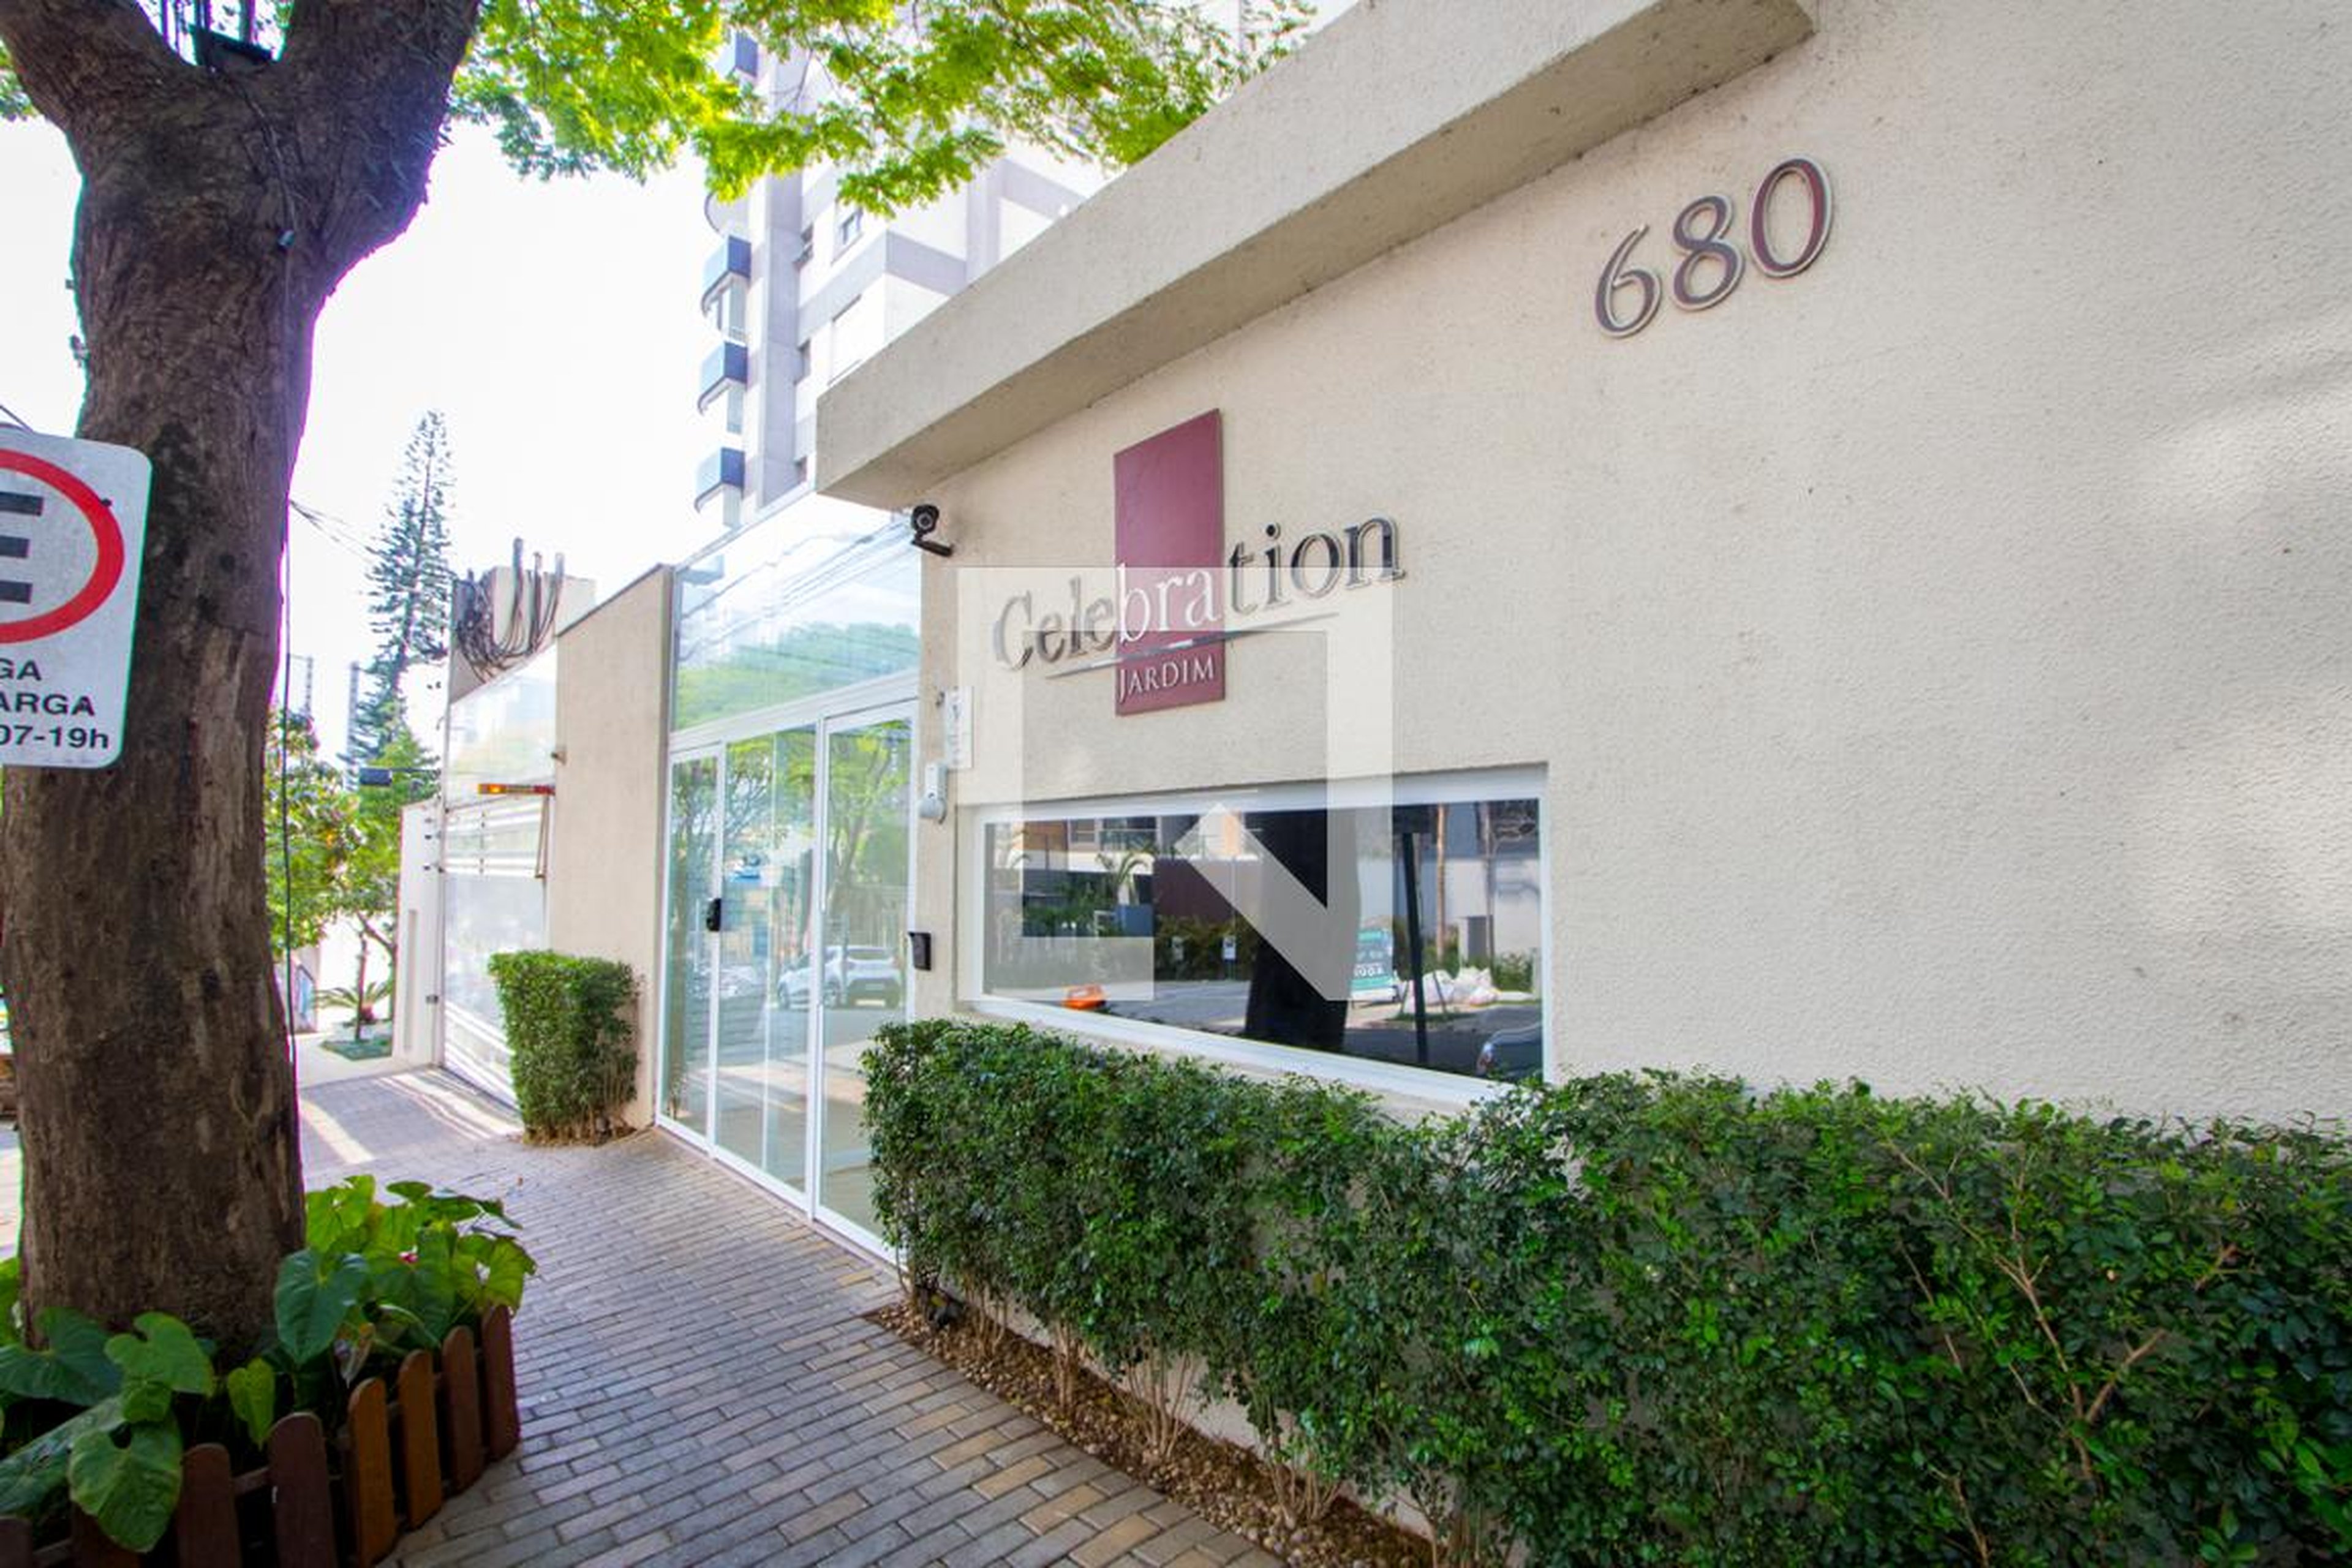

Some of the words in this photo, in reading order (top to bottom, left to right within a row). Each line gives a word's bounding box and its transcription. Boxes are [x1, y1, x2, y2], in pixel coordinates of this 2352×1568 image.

[1595, 155, 1834, 339] 680
[991, 513, 1406, 672] Celebration
[1119, 654, 1215, 704] JARDIM
